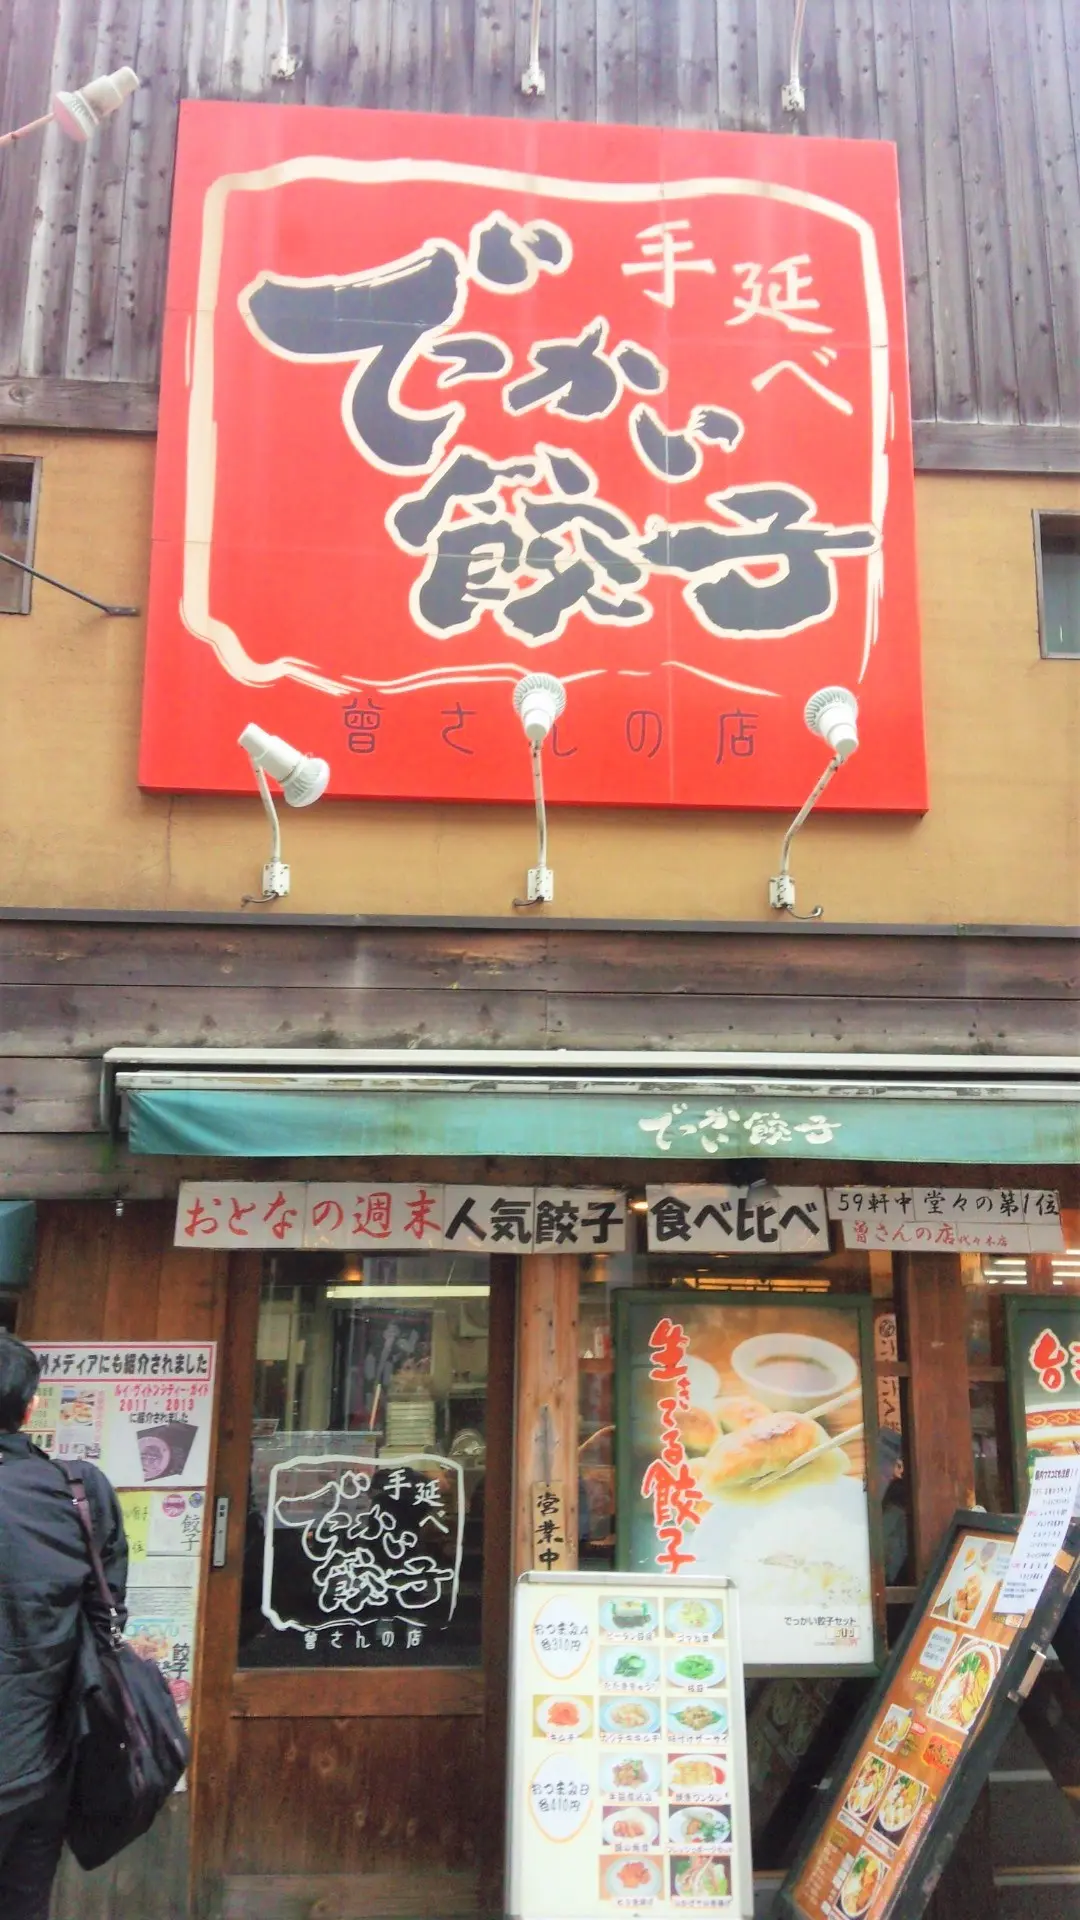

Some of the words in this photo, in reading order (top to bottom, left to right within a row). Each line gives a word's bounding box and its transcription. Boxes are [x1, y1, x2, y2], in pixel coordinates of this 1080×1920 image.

[621, 219, 853, 414] 手延べ
[650, 1196, 821, 1243] 食べ比べ
[640, 1318, 704, 1575] 生きてる餃子
[181, 1514, 202, 1551] 餃子
[383, 1469, 449, 1534] 手延べ
[534, 1492, 564, 1570] 営業中
